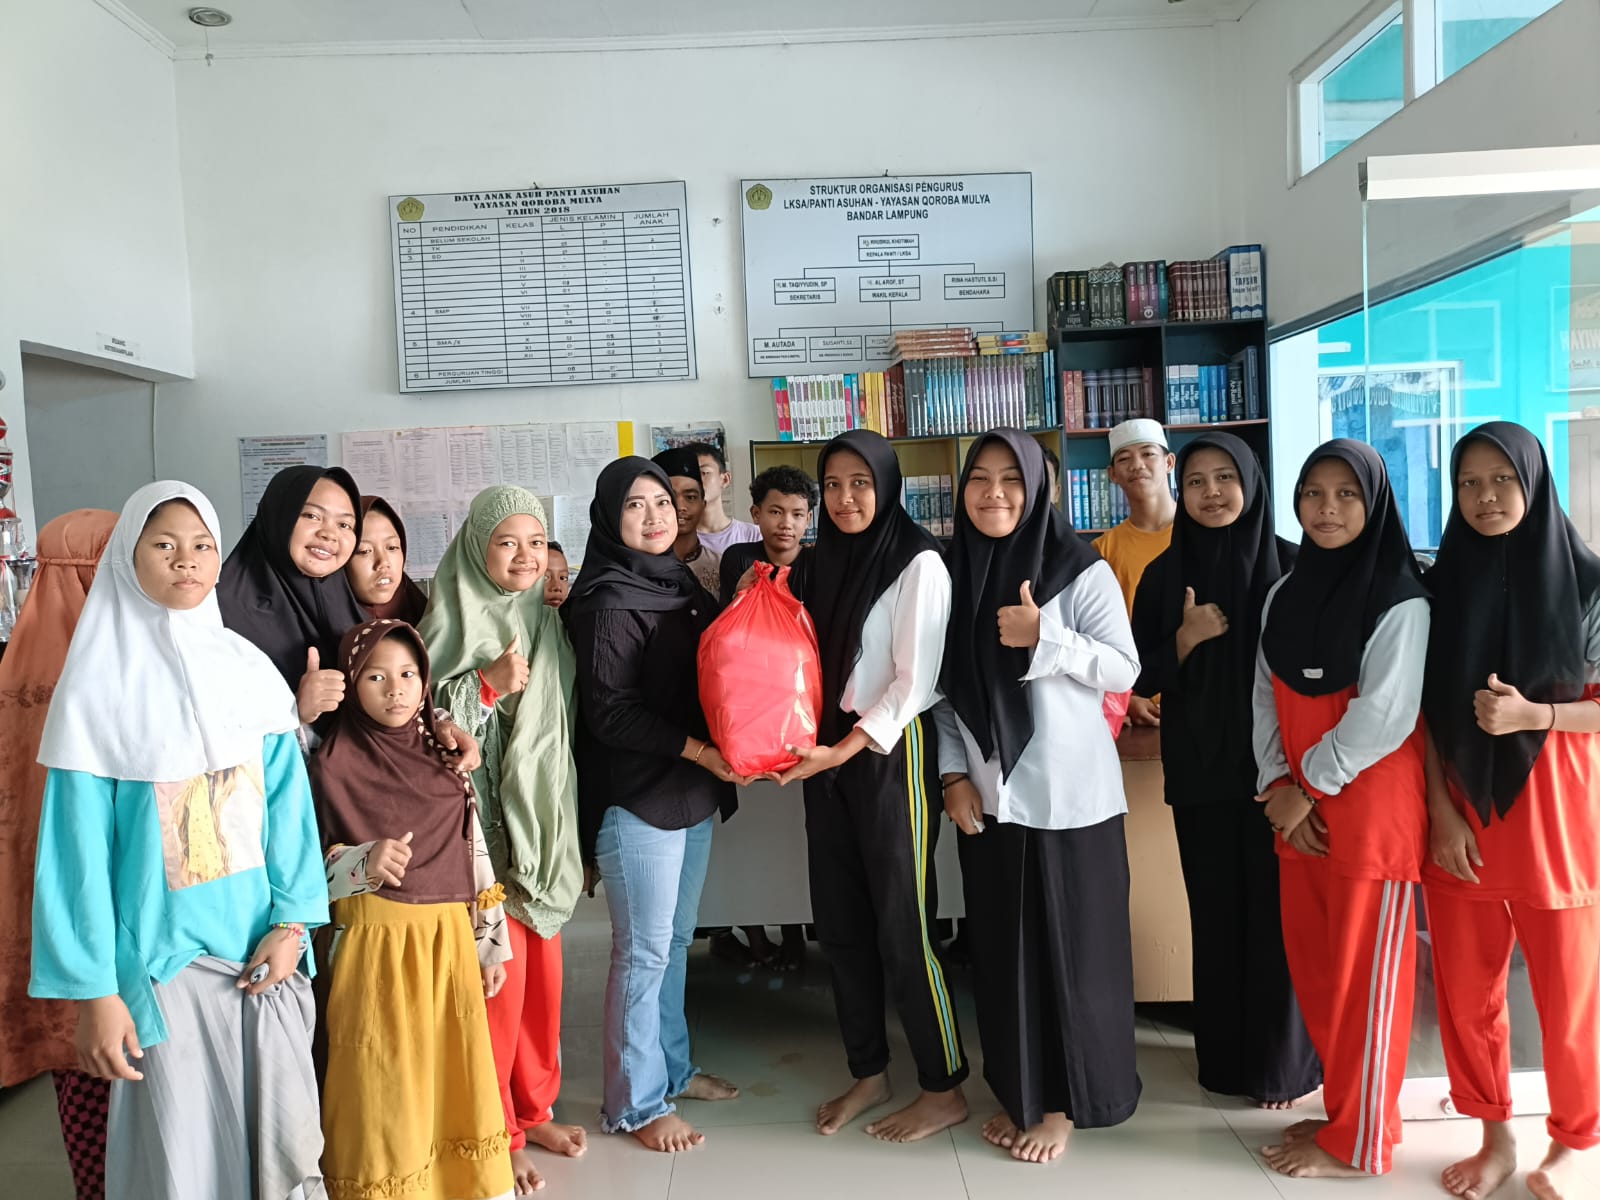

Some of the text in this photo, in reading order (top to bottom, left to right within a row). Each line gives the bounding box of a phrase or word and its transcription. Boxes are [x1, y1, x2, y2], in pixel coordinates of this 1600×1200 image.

[515, 191, 542, 199] ASUH
[546, 189, 577, 197] PANTI
[580, 187, 620, 195] ASUHAN
[810, 182, 964, 195] STRUKTUR ORGANISASI PENGURUS
[473, 196, 603, 210] YAYASAN QOROBA MULYA
[784, 198, 835, 209] LKSA/PANTI
[837, 197, 873, 208] ASUHAN
[880, 196, 920, 206] YAYASAN
[922, 195, 960, 206] QOROBA
[962, 194, 991, 204] MULYA
[506, 206, 570, 216] TAHUN 2018
[634, 212, 669, 220] JUMLAH
[847, 209, 929, 221] BANDAR LAMPUNG
[432, 224, 488, 232] PENDIDIKAN
[505, 221, 535, 229] KELAS
